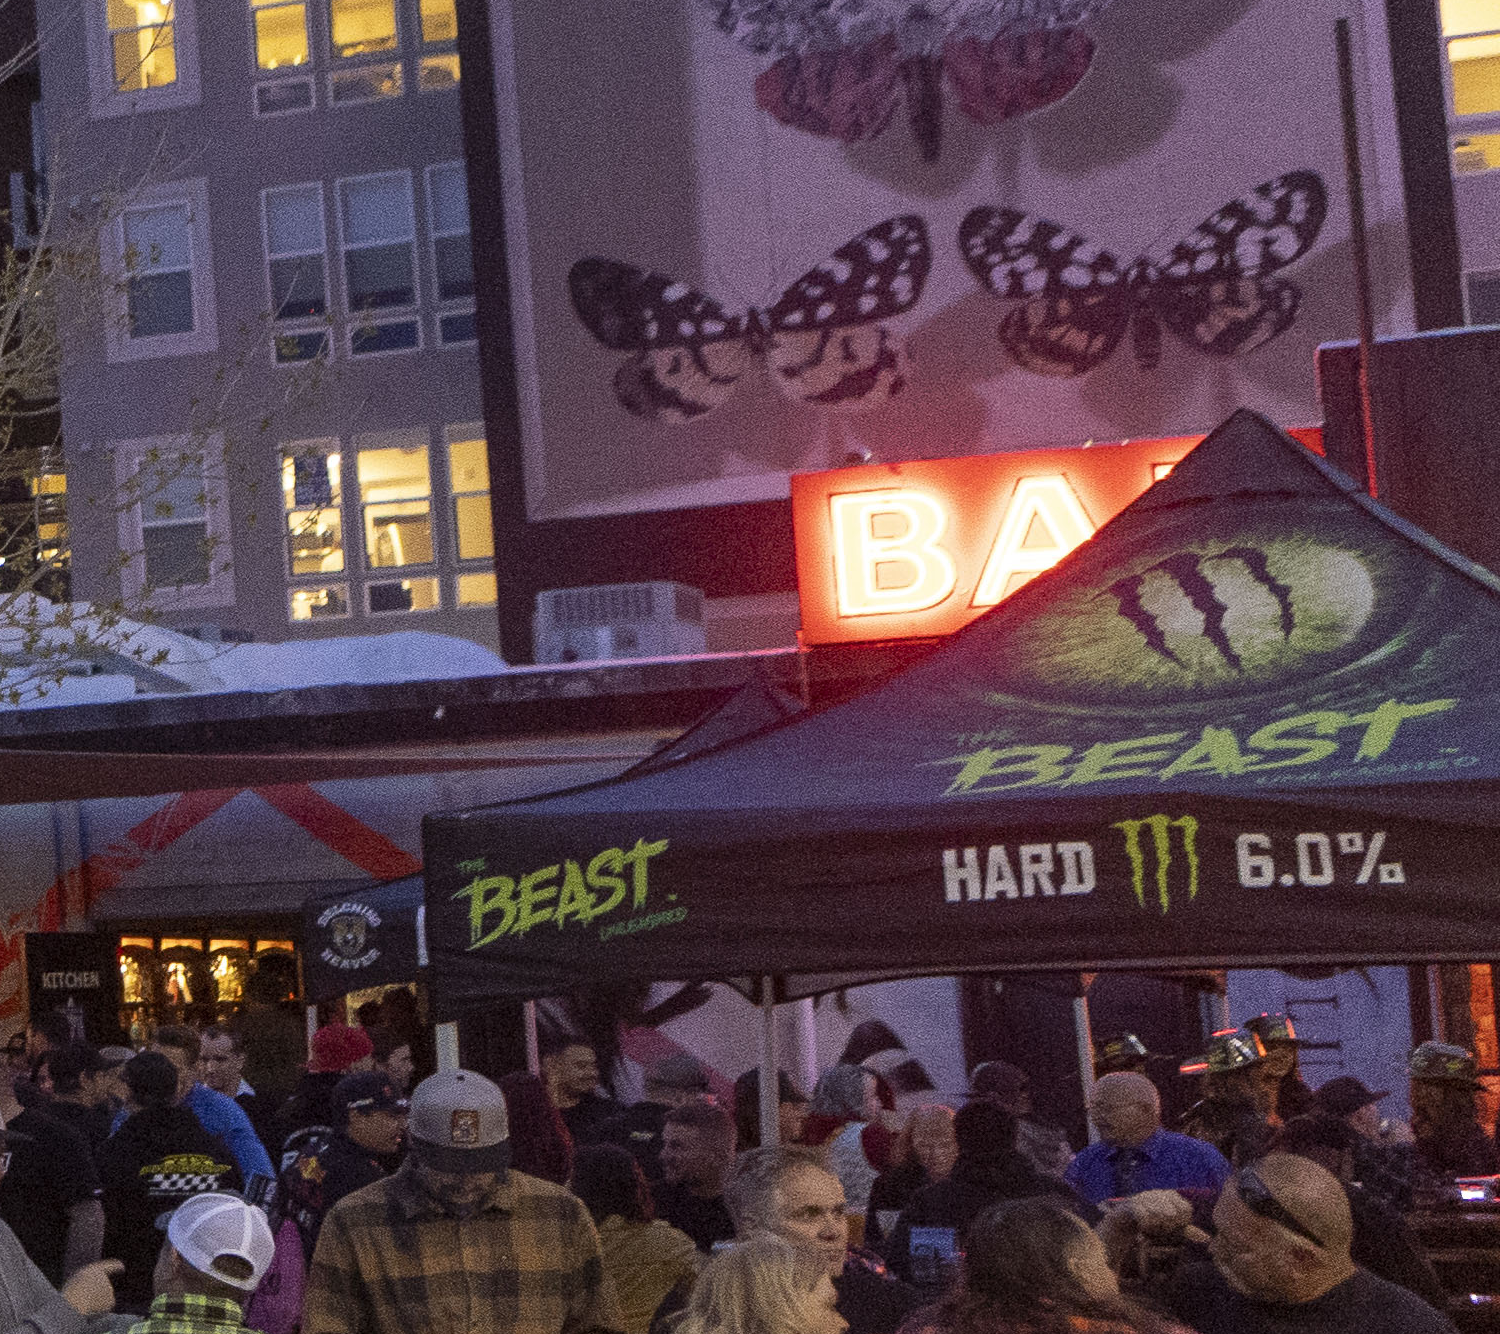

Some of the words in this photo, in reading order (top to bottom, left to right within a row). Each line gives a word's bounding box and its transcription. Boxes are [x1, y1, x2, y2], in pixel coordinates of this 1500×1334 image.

[829, 463, 1180, 618] BA
[930, 699, 1460, 798] BEAST
[451, 838, 670, 951] BEAST
[942, 841, 1097, 903] HARD
[1235, 832, 1406, 888] 6.0%
[42, 970, 100, 989] KITCHEN
